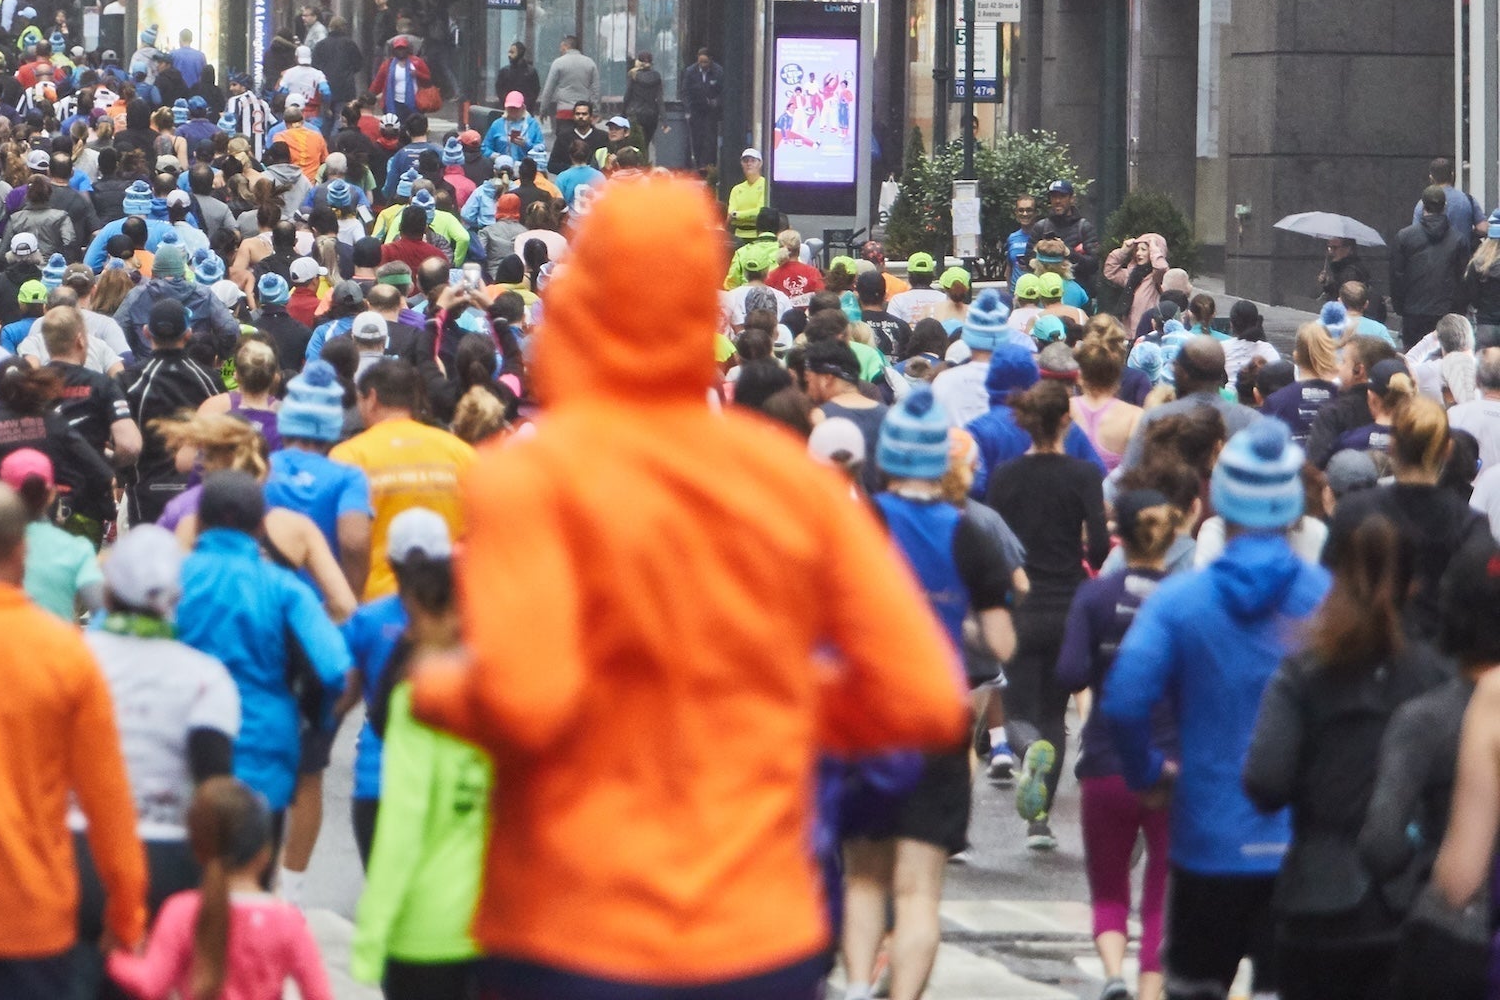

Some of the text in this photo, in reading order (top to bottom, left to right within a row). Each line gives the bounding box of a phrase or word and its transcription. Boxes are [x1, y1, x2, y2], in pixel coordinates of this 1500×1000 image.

[824, 4, 857, 12] LinkNYC
[252, 15, 266, 62] Lexington
[958, 29, 966, 44] 5
